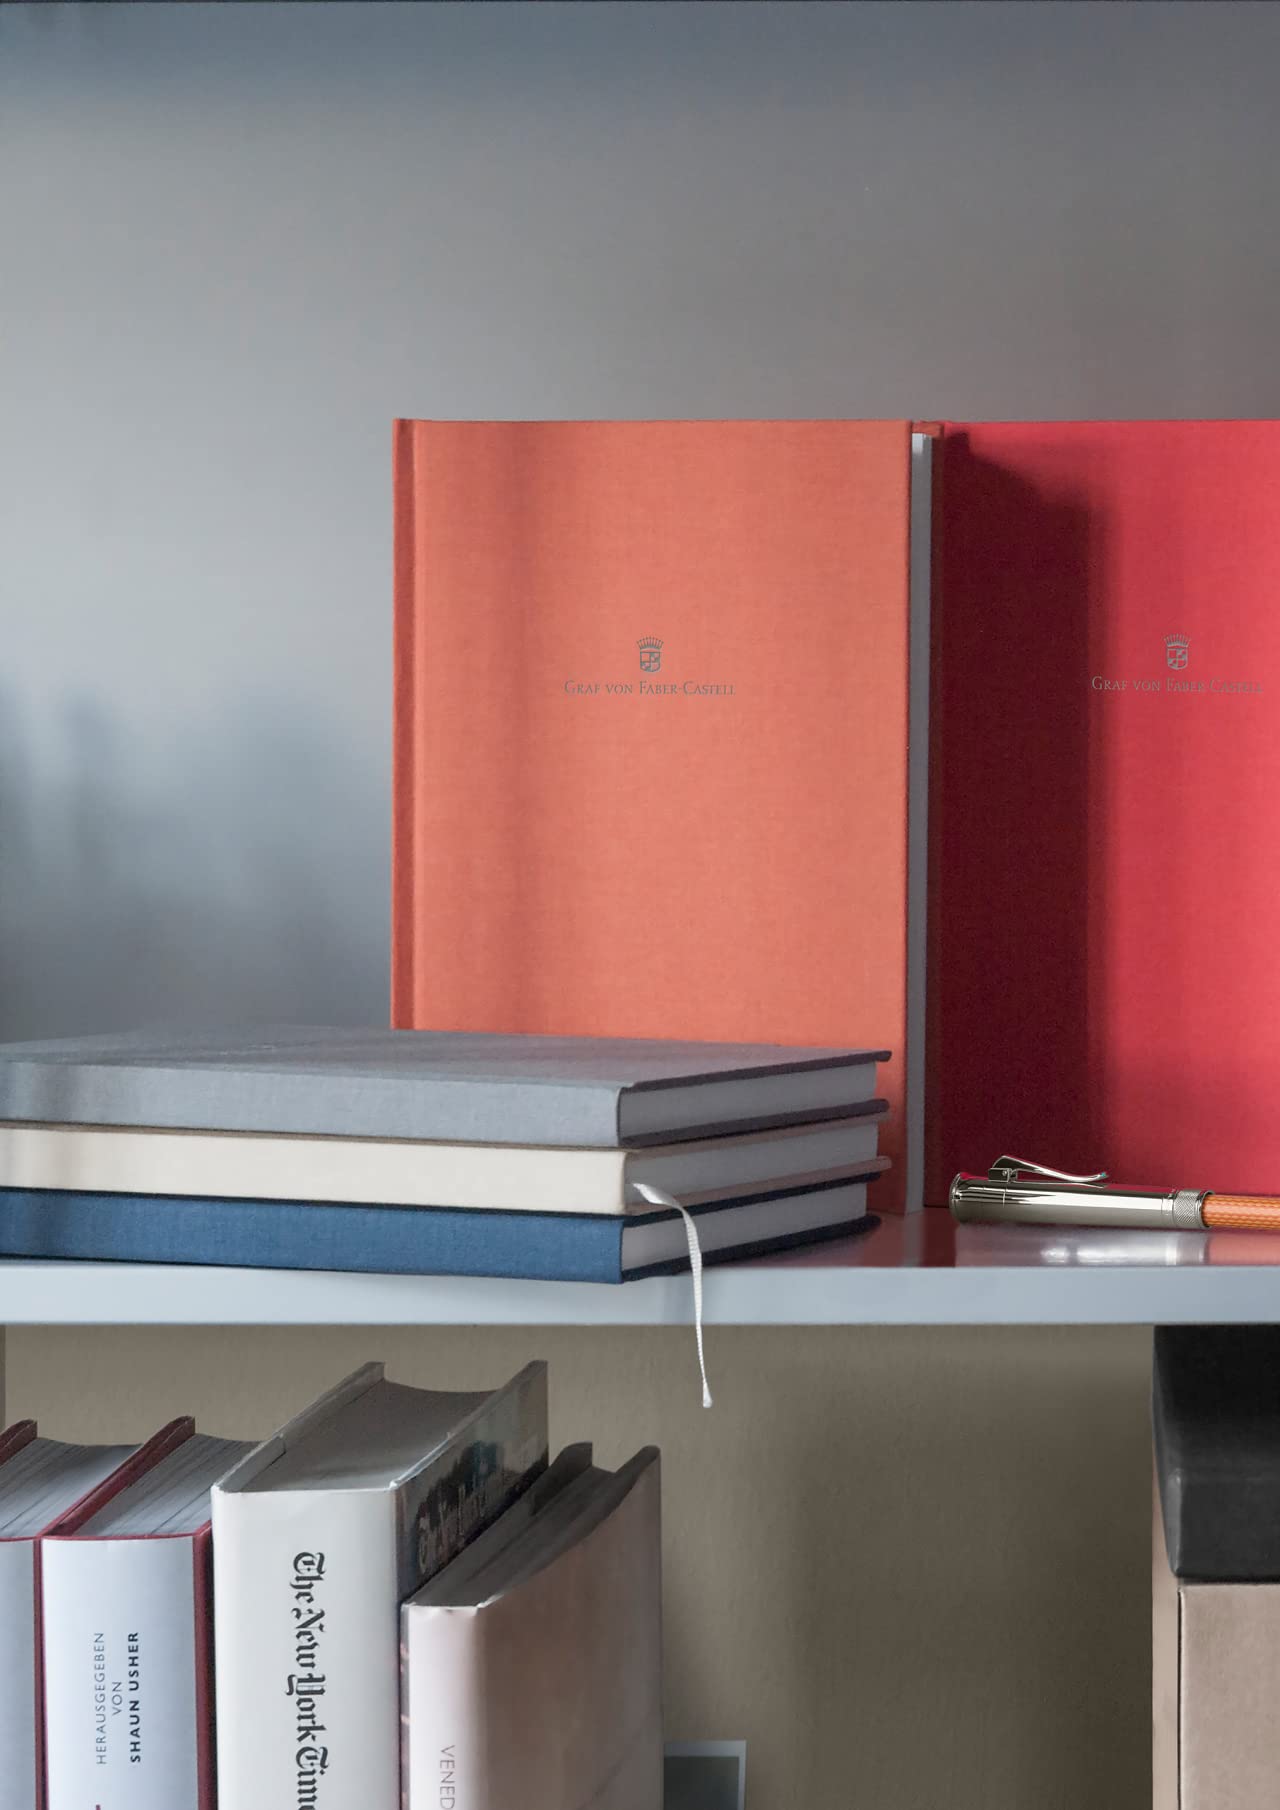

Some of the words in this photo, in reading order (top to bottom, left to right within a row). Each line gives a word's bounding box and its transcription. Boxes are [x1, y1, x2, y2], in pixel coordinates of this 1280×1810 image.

[289, 1551, 326, 1603] The
[128, 1632, 140, 1692] USHER
[291, 1607, 326, 1669] New
[94, 1632, 107, 1765] HERAUSGEGEBEN
[112, 1681, 123, 1716] VON
[286, 1673, 327, 1742] York
[129, 1700, 141, 1763] SHAUN
